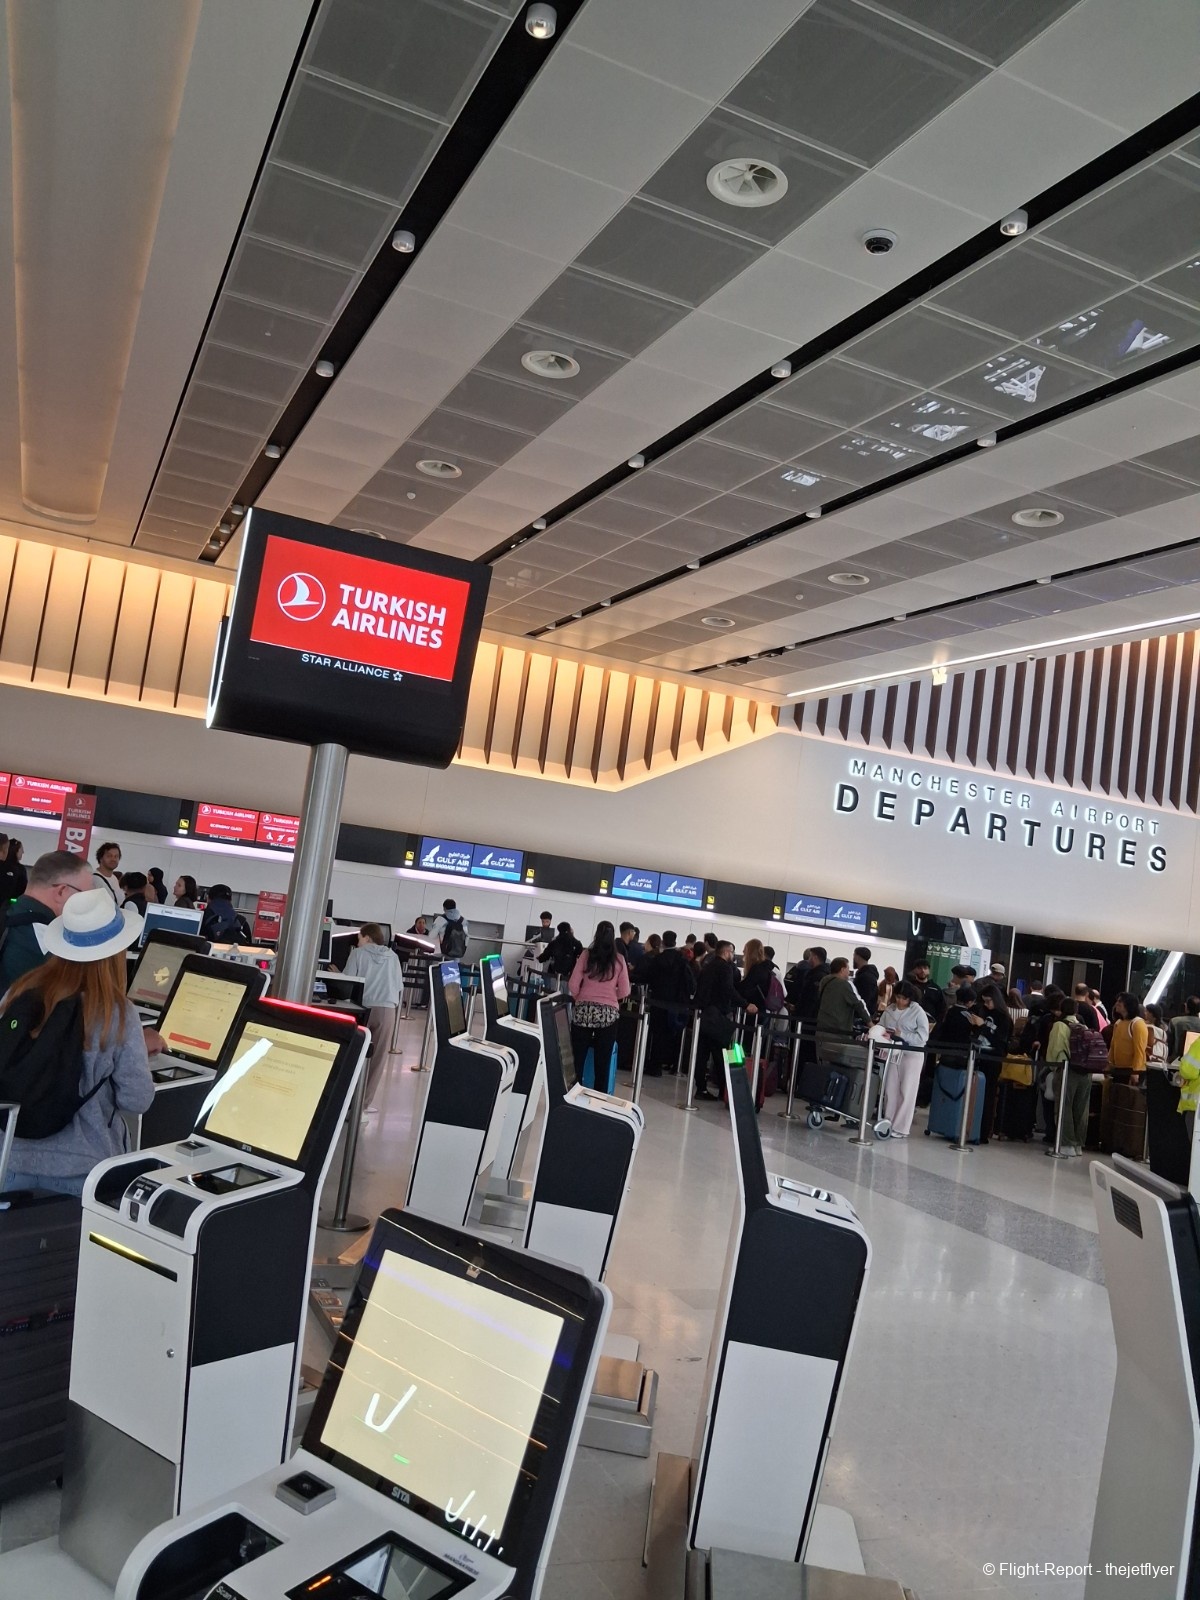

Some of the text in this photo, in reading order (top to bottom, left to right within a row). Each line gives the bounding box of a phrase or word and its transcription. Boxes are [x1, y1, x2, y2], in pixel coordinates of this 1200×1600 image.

[340, 583, 446, 626] TURKISH
[331, 608, 443, 649] AIRLINES
[302, 653, 390, 679] STAR ALLIANCE
[851, 759, 1160, 836] MANCHESTER AIRPORT
[836, 783, 1168, 872] DEPARTURES
[437, 857, 470, 867] GULF AIR
[392, 1486, 410, 1504] SITA
